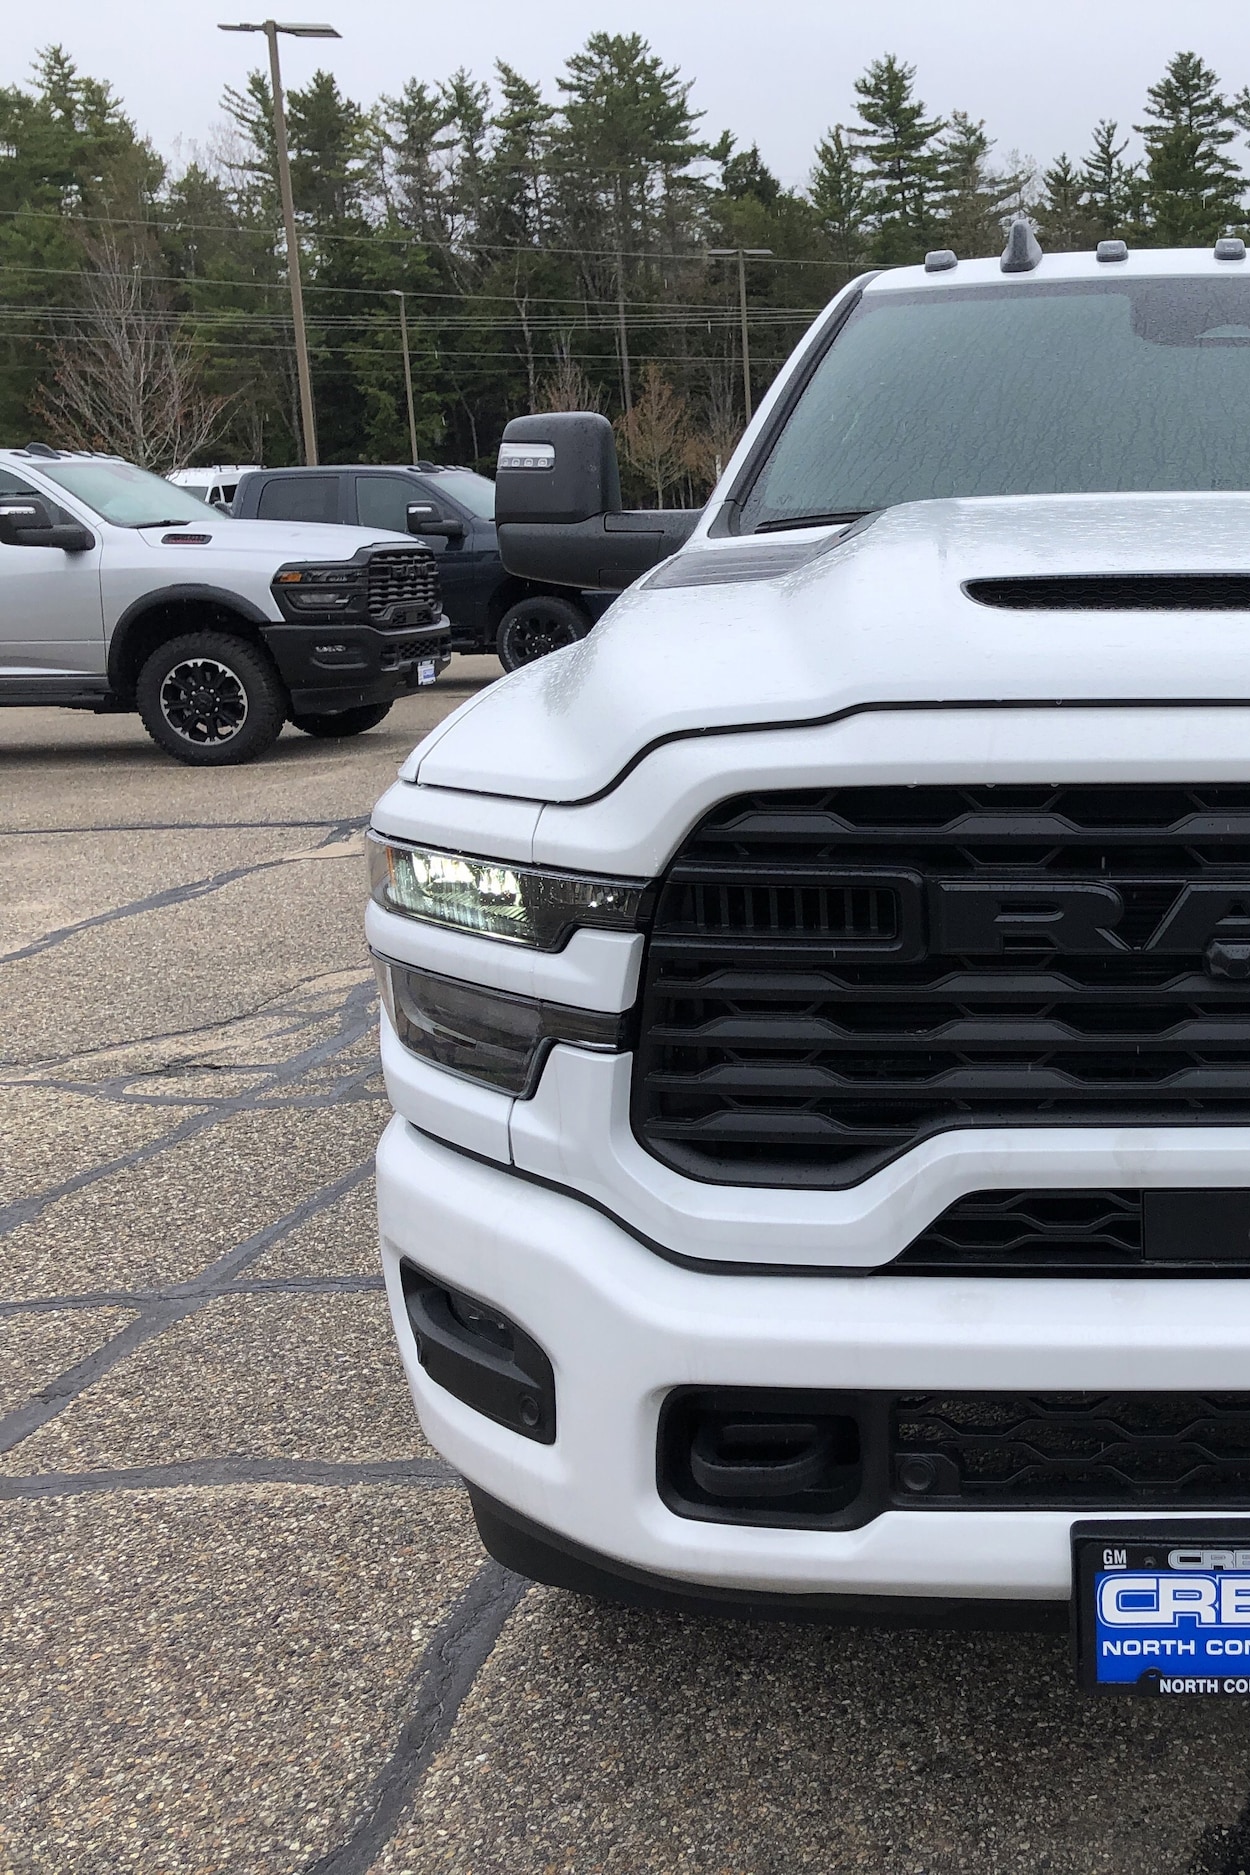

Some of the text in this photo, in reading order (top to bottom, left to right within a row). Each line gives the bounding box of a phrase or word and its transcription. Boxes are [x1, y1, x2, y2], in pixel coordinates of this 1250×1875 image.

[1103, 1549, 1127, 1565] GM
[1102, 1639, 1195, 1656] NORTH
[1159, 1678, 1219, 1694] NORTH
